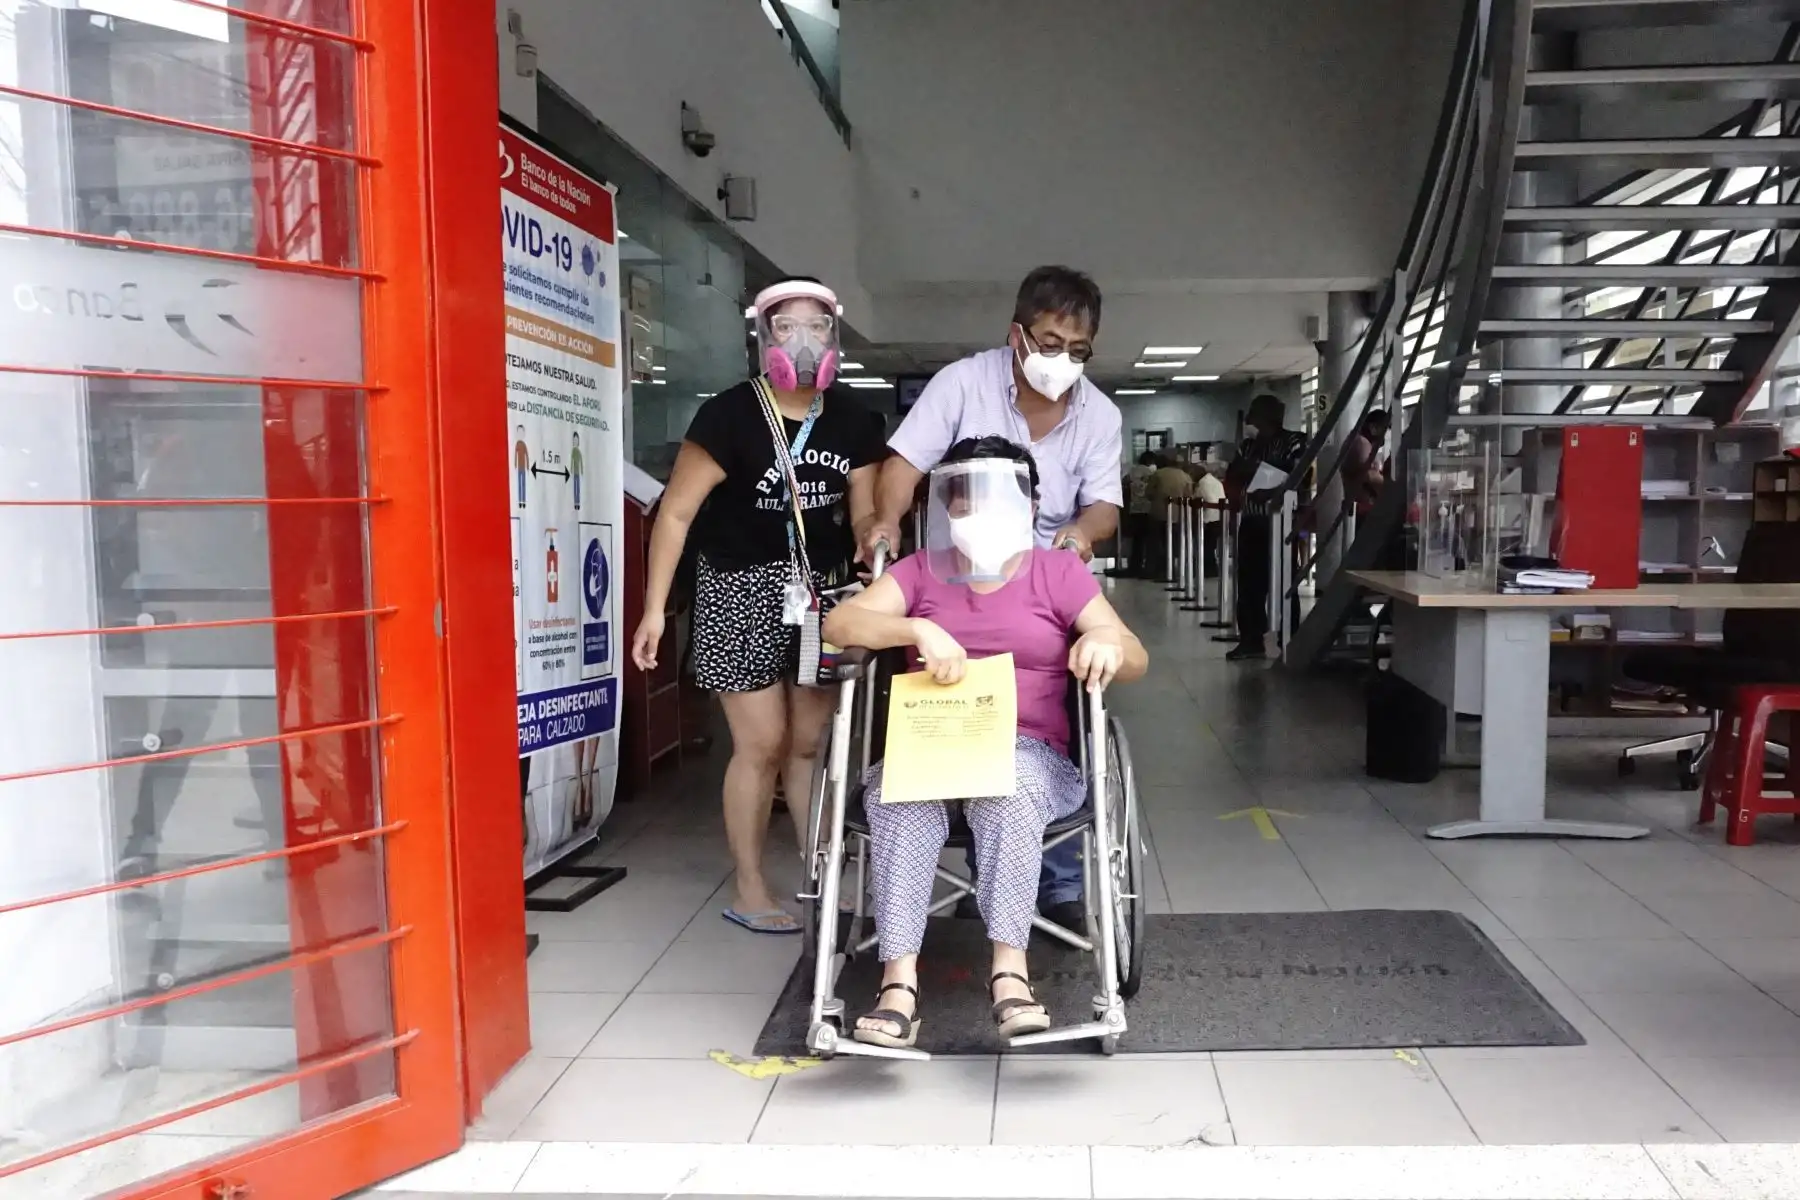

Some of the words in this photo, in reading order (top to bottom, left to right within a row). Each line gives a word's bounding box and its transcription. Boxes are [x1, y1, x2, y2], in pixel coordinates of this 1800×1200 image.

[521, 153, 546, 180] Banco
[547, 170, 557, 187] de
[559, 174, 566, 192] la
[567, 180, 591, 207] Nación
[521, 172, 528, 188] El
[530, 177, 549, 199] banco
[550, 190, 558, 204] de
[560, 195, 577, 214] todos
[500, 205, 572, 272] VID-19
[509, 265, 552, 290] solicitamos
[554, 283, 579, 301] cumplir
[581, 292, 590, 306] las
[535, 292, 595, 324] recomendaciones
[506, 315, 557, 342] PREVENCIÓN
[568, 336, 594, 355] ACCIÓN
[505, 353, 542, 375] TEJAMOS
[544, 364, 574, 383] NUESTRA
[512, 381, 536, 395] ESTAMOS
[537, 387, 572, 404] CONTROLANDO
[573, 393, 581, 406] EL
[518, 403, 526, 412] LA
[526, 401, 564, 421] DISTANCIA
[565, 411, 575, 424] DE
[542, 449, 553, 463] 1.5
[554, 453, 561, 464] m
[530, 645, 562, 658] concentración
[563, 645, 576, 654] entre
[532, 634, 544, 644] base
[545, 634, 551, 642] de
[552, 631, 568, 642] alcohol
[569, 631, 577, 640] con
[538, 687, 608, 720] DESINFECTANTE
[517, 723, 542, 748] PARA
[546, 713, 586, 740] CALZADO
